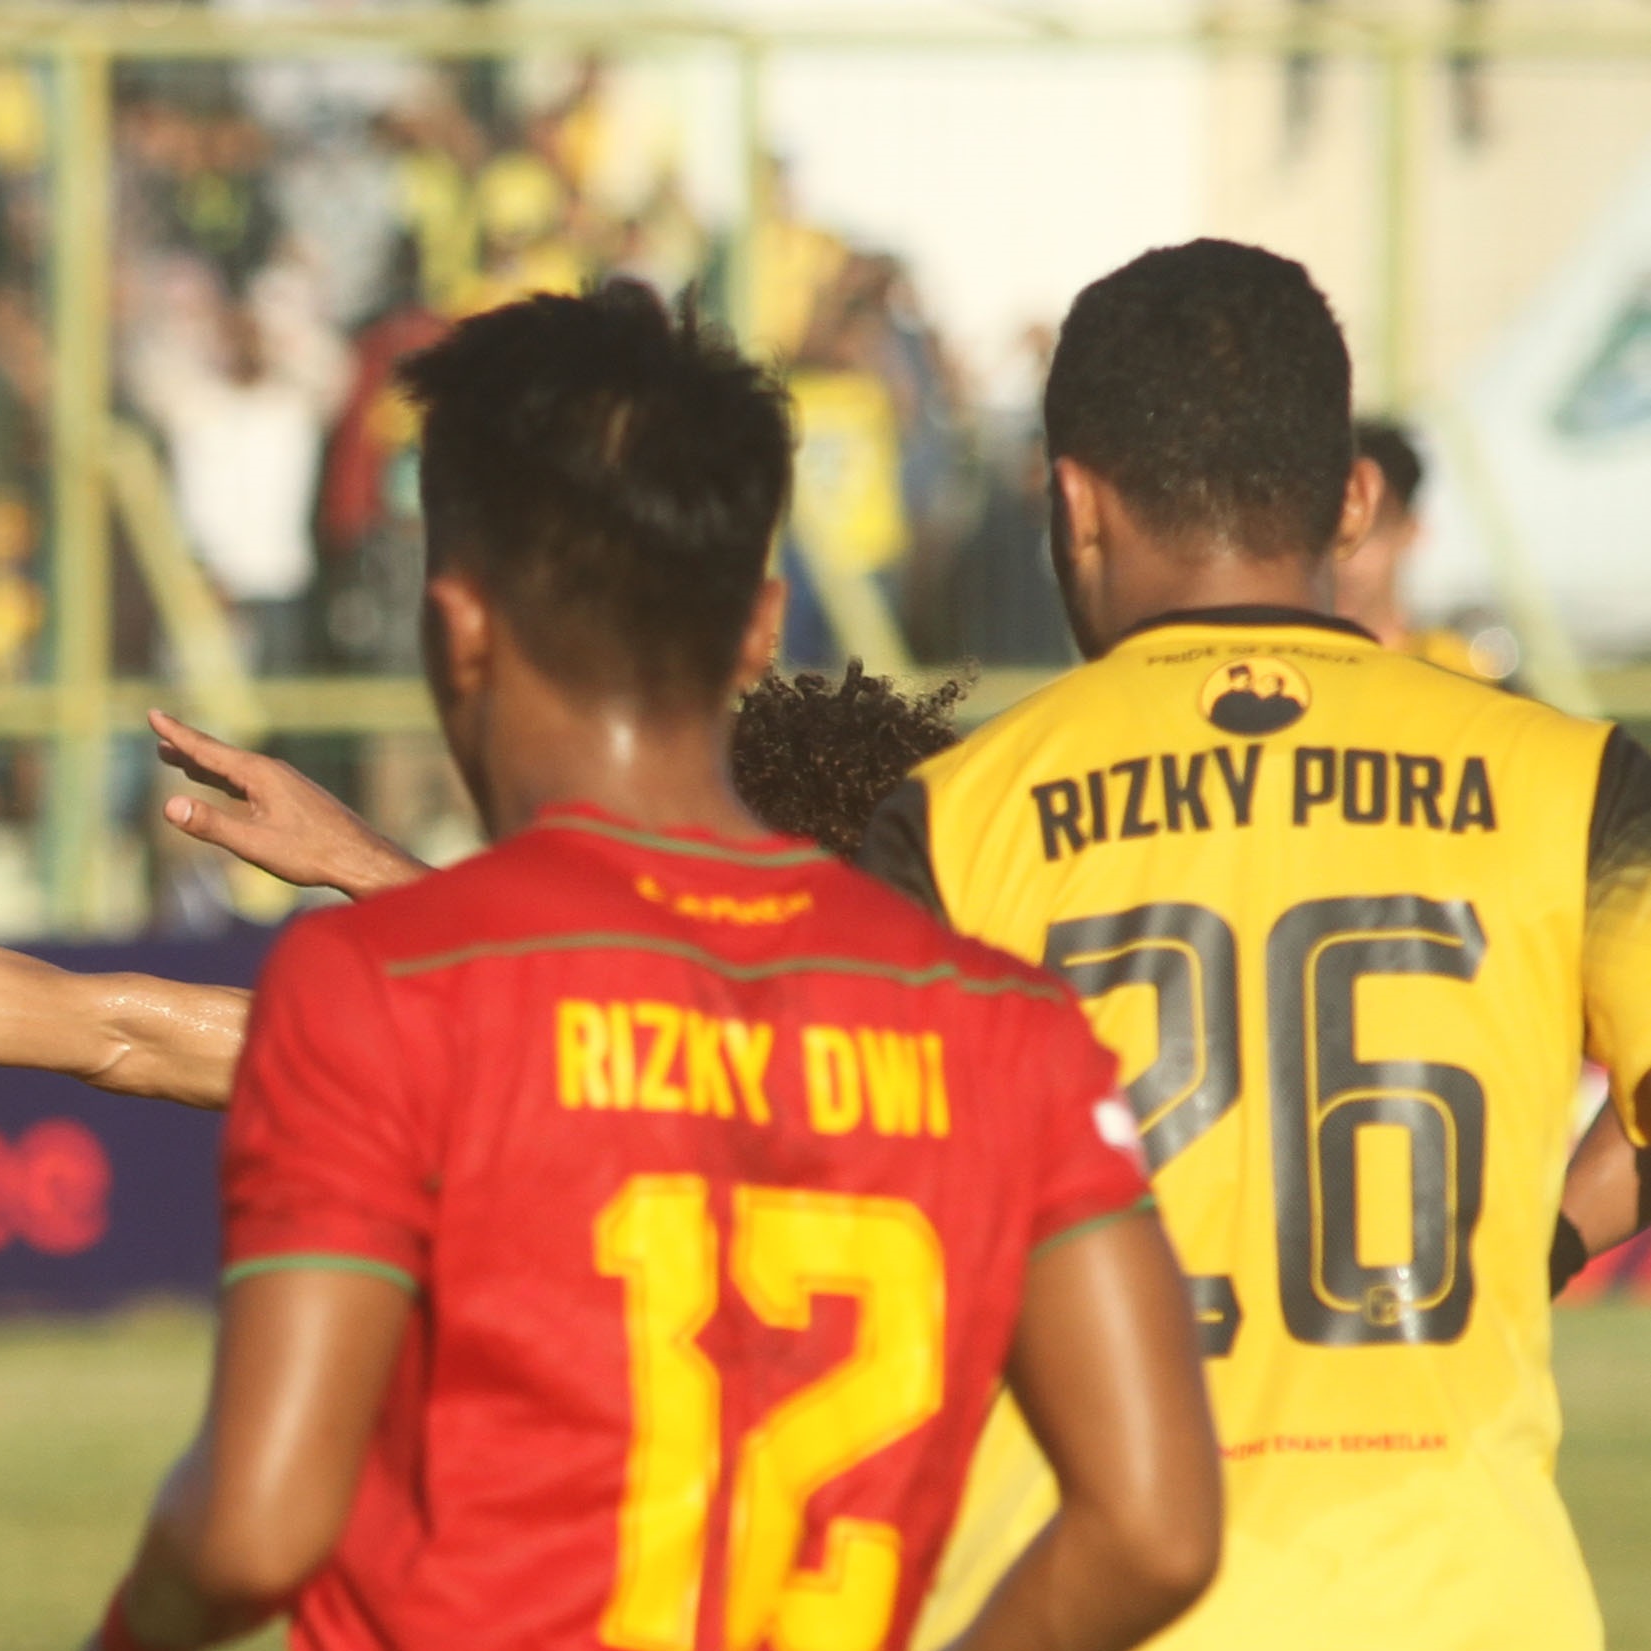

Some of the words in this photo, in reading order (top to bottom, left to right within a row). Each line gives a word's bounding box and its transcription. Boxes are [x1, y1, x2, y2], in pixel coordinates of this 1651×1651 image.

[1030, 743, 1264, 862] RIZKY
[1291, 746, 1497, 834] PORA
[557, 998, 774, 1128] RIZKY
[802, 1023, 950, 1139] DWI
[1043, 894, 1487, 1358] 26
